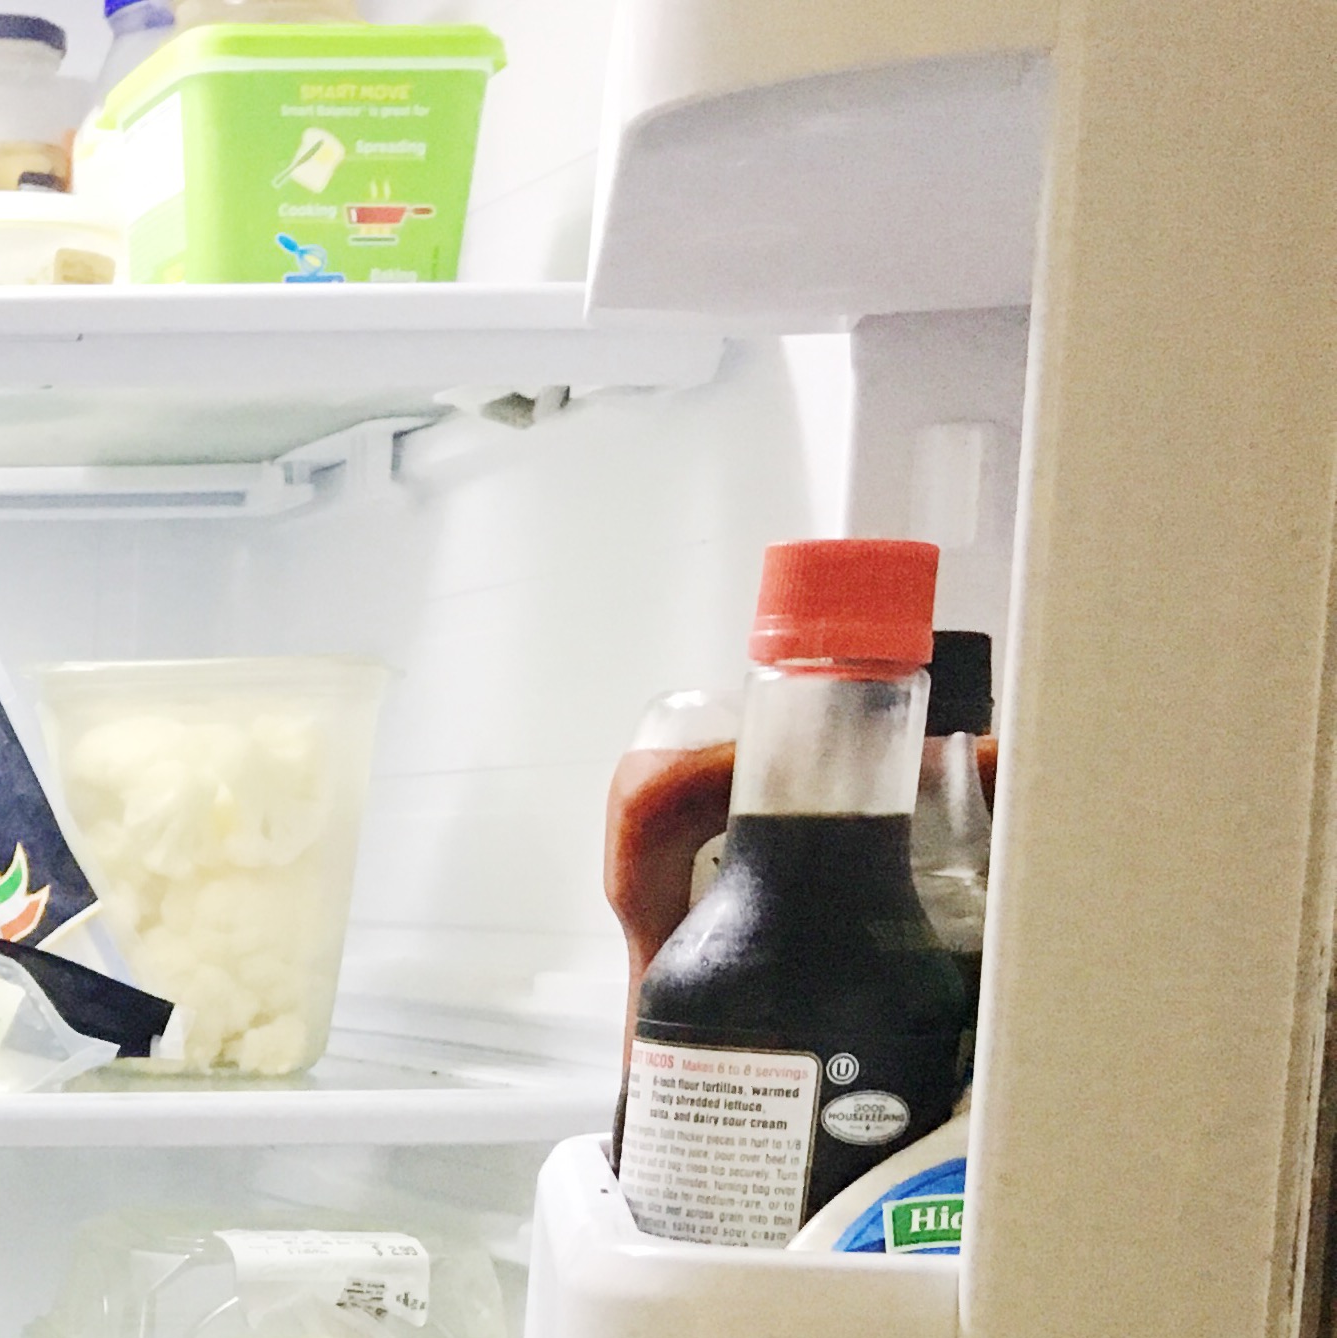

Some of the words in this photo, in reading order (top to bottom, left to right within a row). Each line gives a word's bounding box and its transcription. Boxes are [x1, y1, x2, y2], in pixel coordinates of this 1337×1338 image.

[278, 202, 337, 222] Cooking
[728, 1064, 740, 1076] to
[755, 1066, 810, 1081] servings
[751, 1086, 800, 1099] warmed
[676, 1095, 720, 1109] shredded
[674, 1111, 691, 1123] and
[693, 1111, 719, 1127] dairy
[722, 1116, 747, 1127] sour
[750, 1118, 788, 1131] cream
[750, 1138, 770, 1149] half
[772, 1139, 783, 1150] to
[787, 1140, 802, 1151] 1/8
[739, 1153, 761, 1163] over
[765, 1153, 787, 1166] beef
[752, 1183, 770, 1197] bag
[773, 1187, 797, 1197] over
[784, 1201, 796, 1212] to
[719, 1212, 744, 1224] grain
[699, 1225, 719, 1237] and
[722, 1227, 747, 1239] sour
